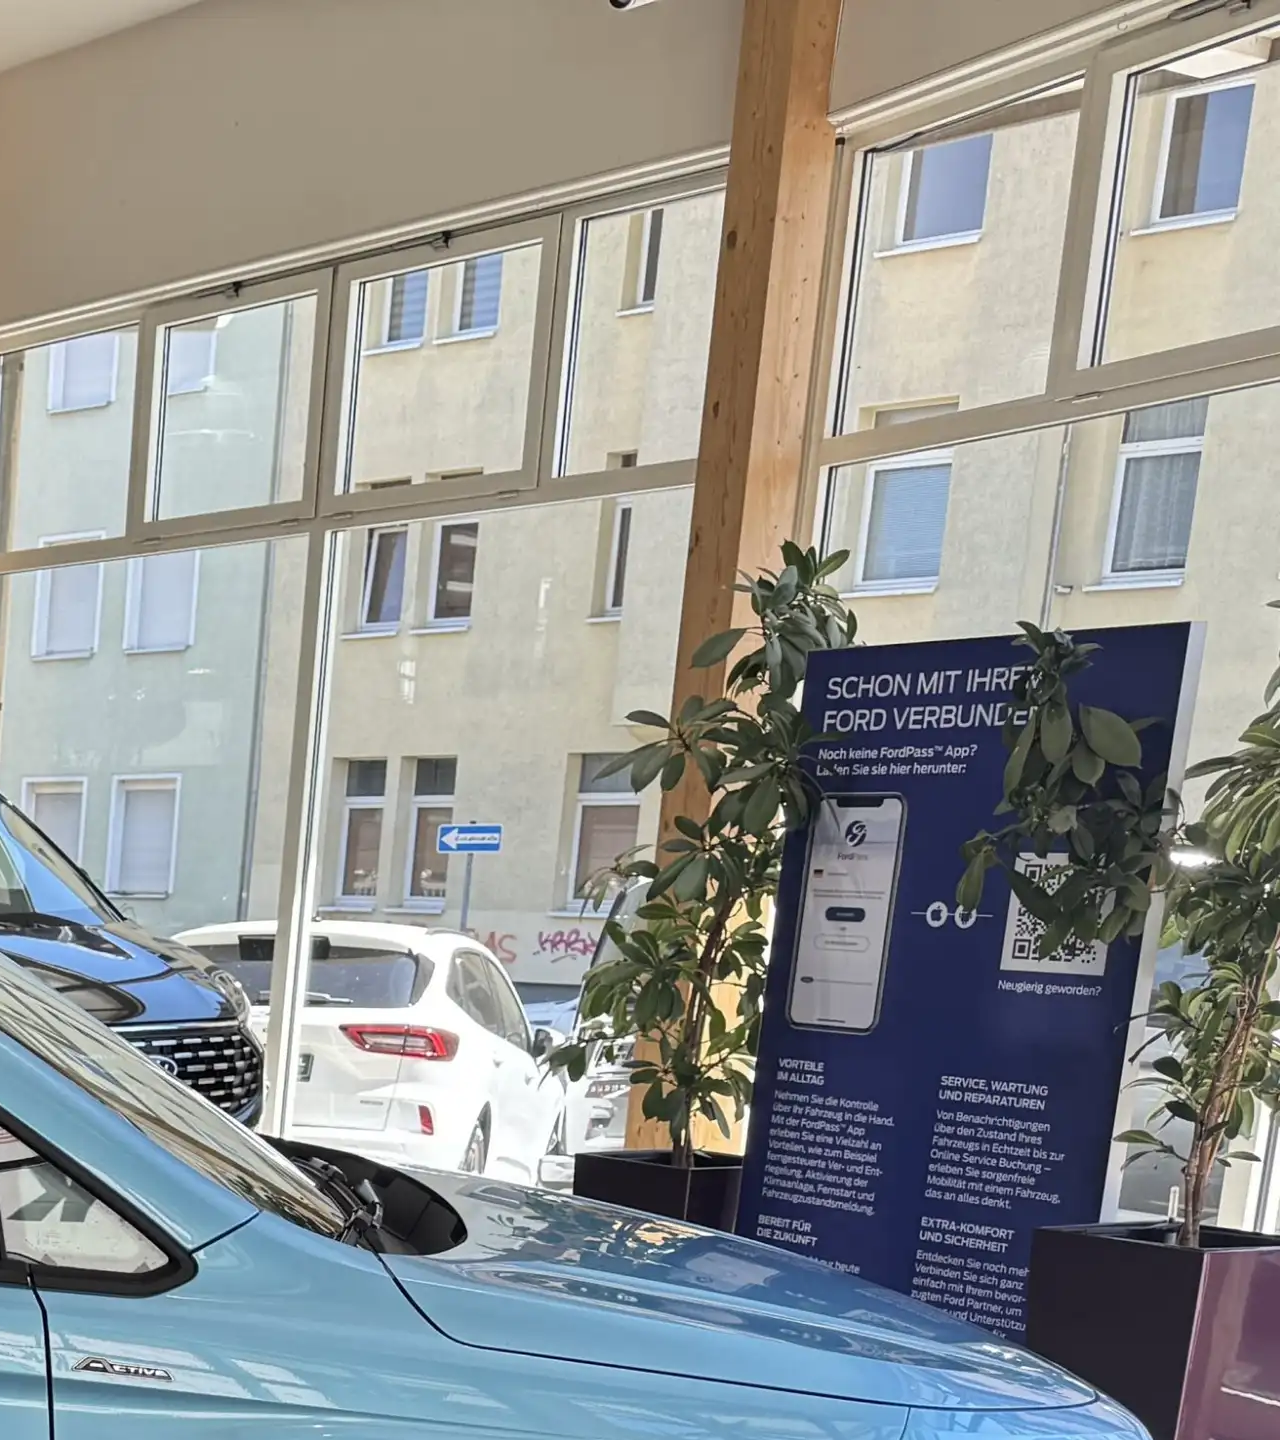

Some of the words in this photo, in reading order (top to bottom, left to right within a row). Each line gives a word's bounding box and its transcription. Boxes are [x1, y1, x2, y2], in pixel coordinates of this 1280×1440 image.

[826, 672, 911, 700] SCHON
[916, 670, 962, 696] MIT
[822, 709, 887, 733] FORD
[819, 748, 848, 760] Noch
[849, 748, 878, 760] keine
[944, 744, 978, 758] App?
[852, 764, 869, 776] Sie
[871, 764, 887, 775] sie
[890, 762, 911, 775] hier
[913, 762, 966, 774] herunter:
[998, 980, 1043, 994] Neugierig
[1045, 983, 1102, 996] geworden?
[779, 1058, 825, 1072] VORTEILE
[777, 1071, 788, 1081] IM
[789, 1073, 825, 1086] ALLTAG
[941, 1075, 989, 1091] SERVICE,
[990, 1081, 1049, 1096] WARTUNG
[774, 1089, 809, 1103] Nehmen
[810, 1094, 824, 1104] Sie
[825, 1096, 838, 1107] die
[840, 1098, 879, 1111] Kontrolle
[939, 1090, 962, 1101] UND
[964, 1092, 1046, 1111] REPARATUREN
[771, 1114, 784, 1125] Mit
[785, 1116, 799, 1126] der
[847, 1125, 866, 1136] App
[772, 1102, 791, 1112] über
[793, 1104, 803, 1114] Ihr
[805, 1106, 843, 1122] Fahrzeug
[845, 1112, 852, 1120] in
[854, 1112, 868, 1123] die
[869, 1114, 895, 1126] Hand.
[937, 1109, 954, 1120] Von
[956, 1111, 1050, 1133] Benachrichtigungen
[769, 1127, 800, 1139] erleben
[801, 1131, 814, 1142] Sie
[816, 1134, 833, 1144] eine
[835, 1136, 869, 1148] Vielzahl
[870, 1142, 882, 1151] an
[934, 1122, 955, 1134] über
[957, 1125, 975, 1136] den
[976, 1128, 1016, 1142] Zustand
[1019, 1133, 1042, 1145] Ihres
[808, 1145, 823, 1155] wie
[824, 1148, 842, 1157] zum
[844, 1149, 877, 1163] Beispiel
[932, 1136, 980, 1151] Fahrzeugs
[982, 1141, 990, 1152] in
[992, 1143, 1031, 1157] Echtzeit
[1033, 1149, 1047, 1159] bis
[1049, 1152, 1065, 1161] zur
[767, 1151, 826, 1169] ferngesteuerte
[829, 1160, 845, 1170] Ver-
[847, 1164, 863, 1174] und
[865, 1166, 883, 1177] Ent-
[930, 1149, 961, 1162] Online
[962, 1153, 997, 1166] Service
[999, 1158, 1042, 1174] Buchung
[805, 1170, 852, 1187] Aktivierung
[854, 1178, 868, 1188] der
[929, 1163, 963, 1175] erleben
[965, 1167, 980, 1177] Sie
[981, 1170, 1036, 1185] sorgenfreie
[817, 1184, 856, 1199] Fernstart
[858, 1191, 875, 1202] und
[927, 1175, 966, 1189] Mobilität
[968, 1181, 983, 1191] mit
[984, 1184, 1013, 1196] einem
[925, 1188, 943, 1199] das
[944, 1191, 956, 1200] an
[957, 1193, 980, 1204] alles
[981, 1196, 1012, 1209] denkt.
[758, 1214, 791, 1229] BEREIT
[792, 1220, 812, 1232] FÜR
[921, 1216, 1015, 1240] EXTRA-KOMFORT
[756, 1227, 772, 1238] DIE
[773, 1230, 818, 1247] ZUKUNFT
[919, 1230, 942, 1242] UND
[944, 1234, 1008, 1253] SICHERHEIT
[916, 1250, 964, 1266] Entdecken
[966, 1258, 982, 1269] Sie
[983, 1262, 1007, 1274] noch
[915, 1263, 961, 1279] Verbinden
[963, 1271, 978, 1283] Sie
[979, 1275, 998, 1286] sich
[1000, 1279, 1024, 1290] ganz
[913, 1277, 946, 1290] einfach
[948, 1283, 964, 1293] mit
[966, 1285, 993, 1298] Ihrem
[995, 1290, 1026, 1303] bevor-
[911, 1290, 941, 1302] zugten
[943, 1294, 965, 1306] Ford
[967, 1299, 1003, 1315] Partner,
[1006, 1307, 1022, 1316] um
